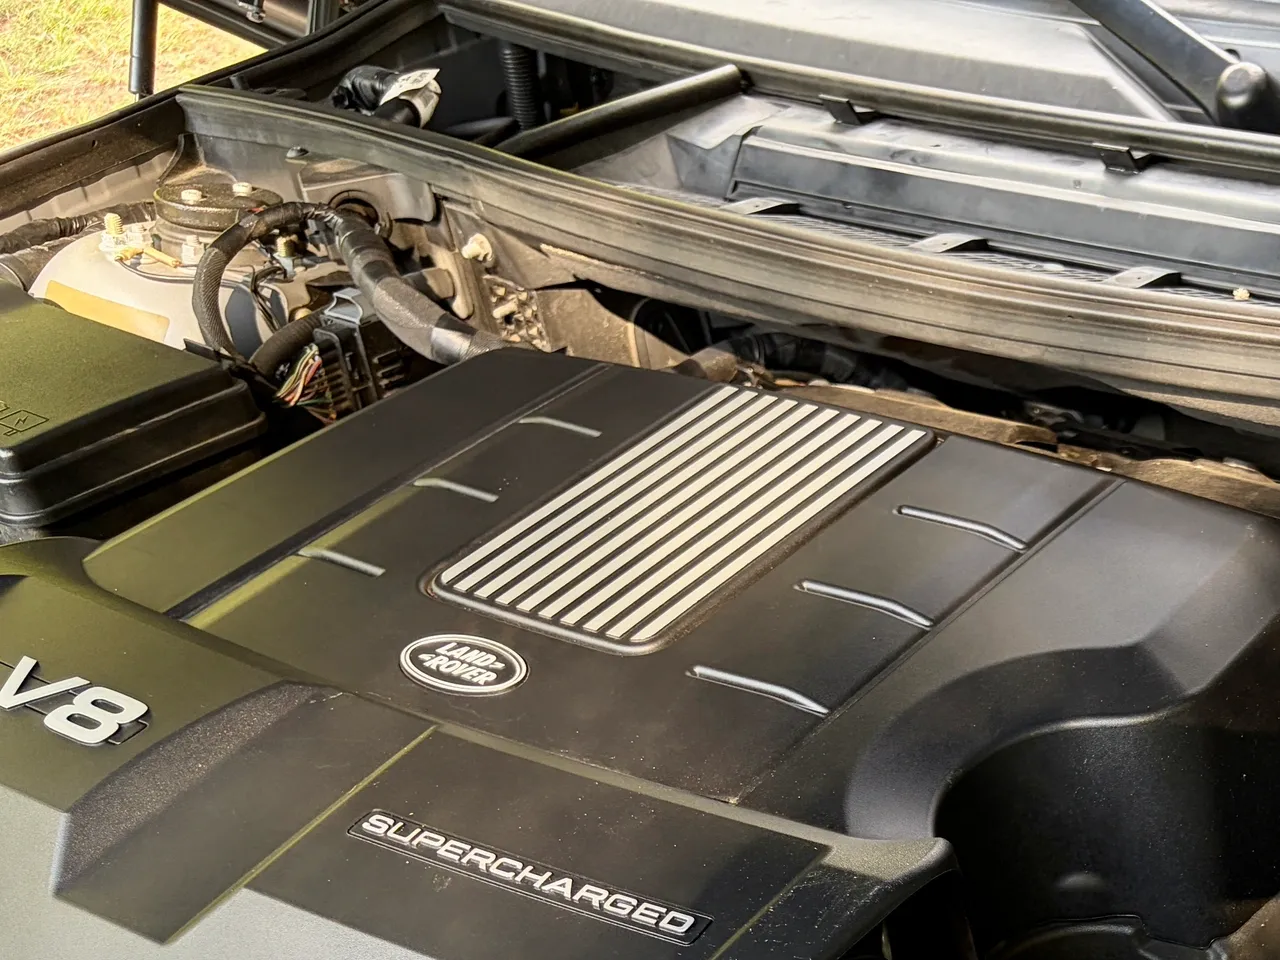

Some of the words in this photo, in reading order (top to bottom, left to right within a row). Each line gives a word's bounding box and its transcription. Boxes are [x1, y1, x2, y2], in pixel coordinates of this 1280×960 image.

[423, 656, 498, 685] ROVER
[435, 642, 498, 667] LAND
[0, 655, 149, 744] V8
[362, 814, 697, 935] SUPERCHARGED
